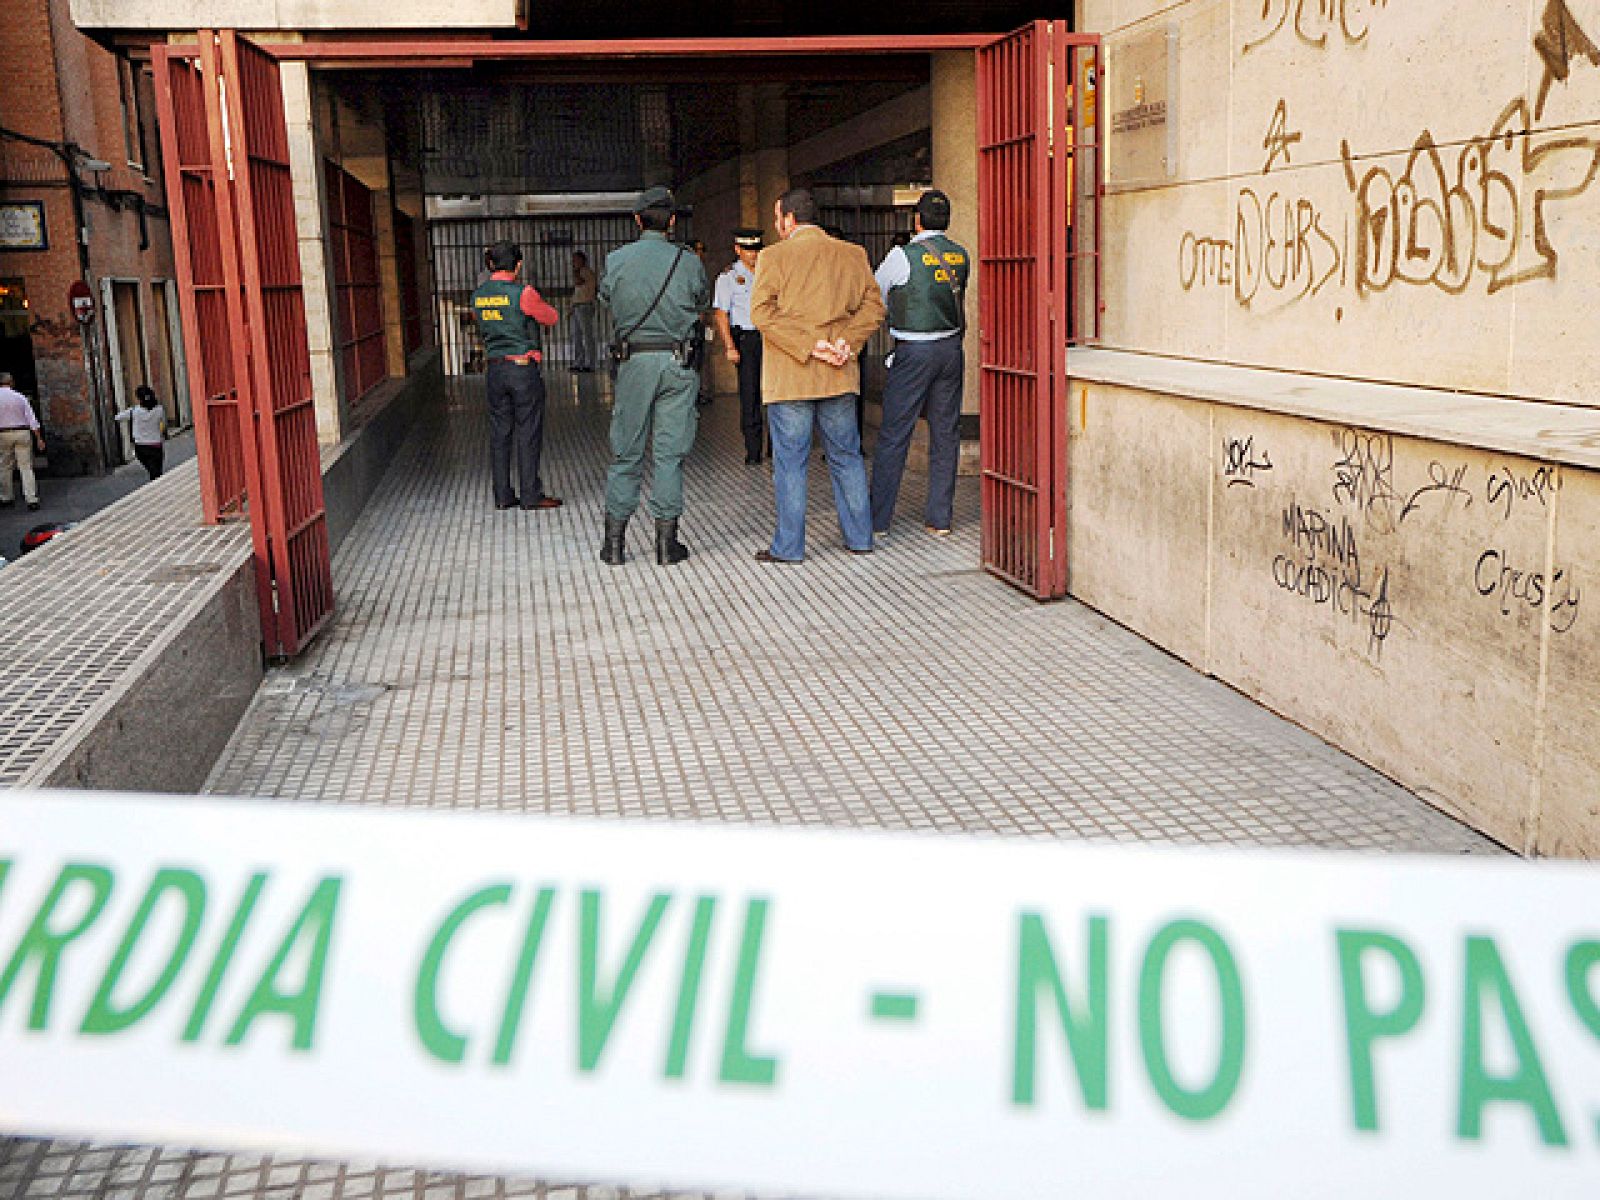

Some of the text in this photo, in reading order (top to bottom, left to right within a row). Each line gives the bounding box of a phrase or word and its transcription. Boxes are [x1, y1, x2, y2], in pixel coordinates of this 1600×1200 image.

[922, 253, 965, 265] GUADIA
[0, 860, 341, 1051] RDIA
[414, 883, 776, 1085] CIVIL
[1012, 912, 1246, 1121] NO
